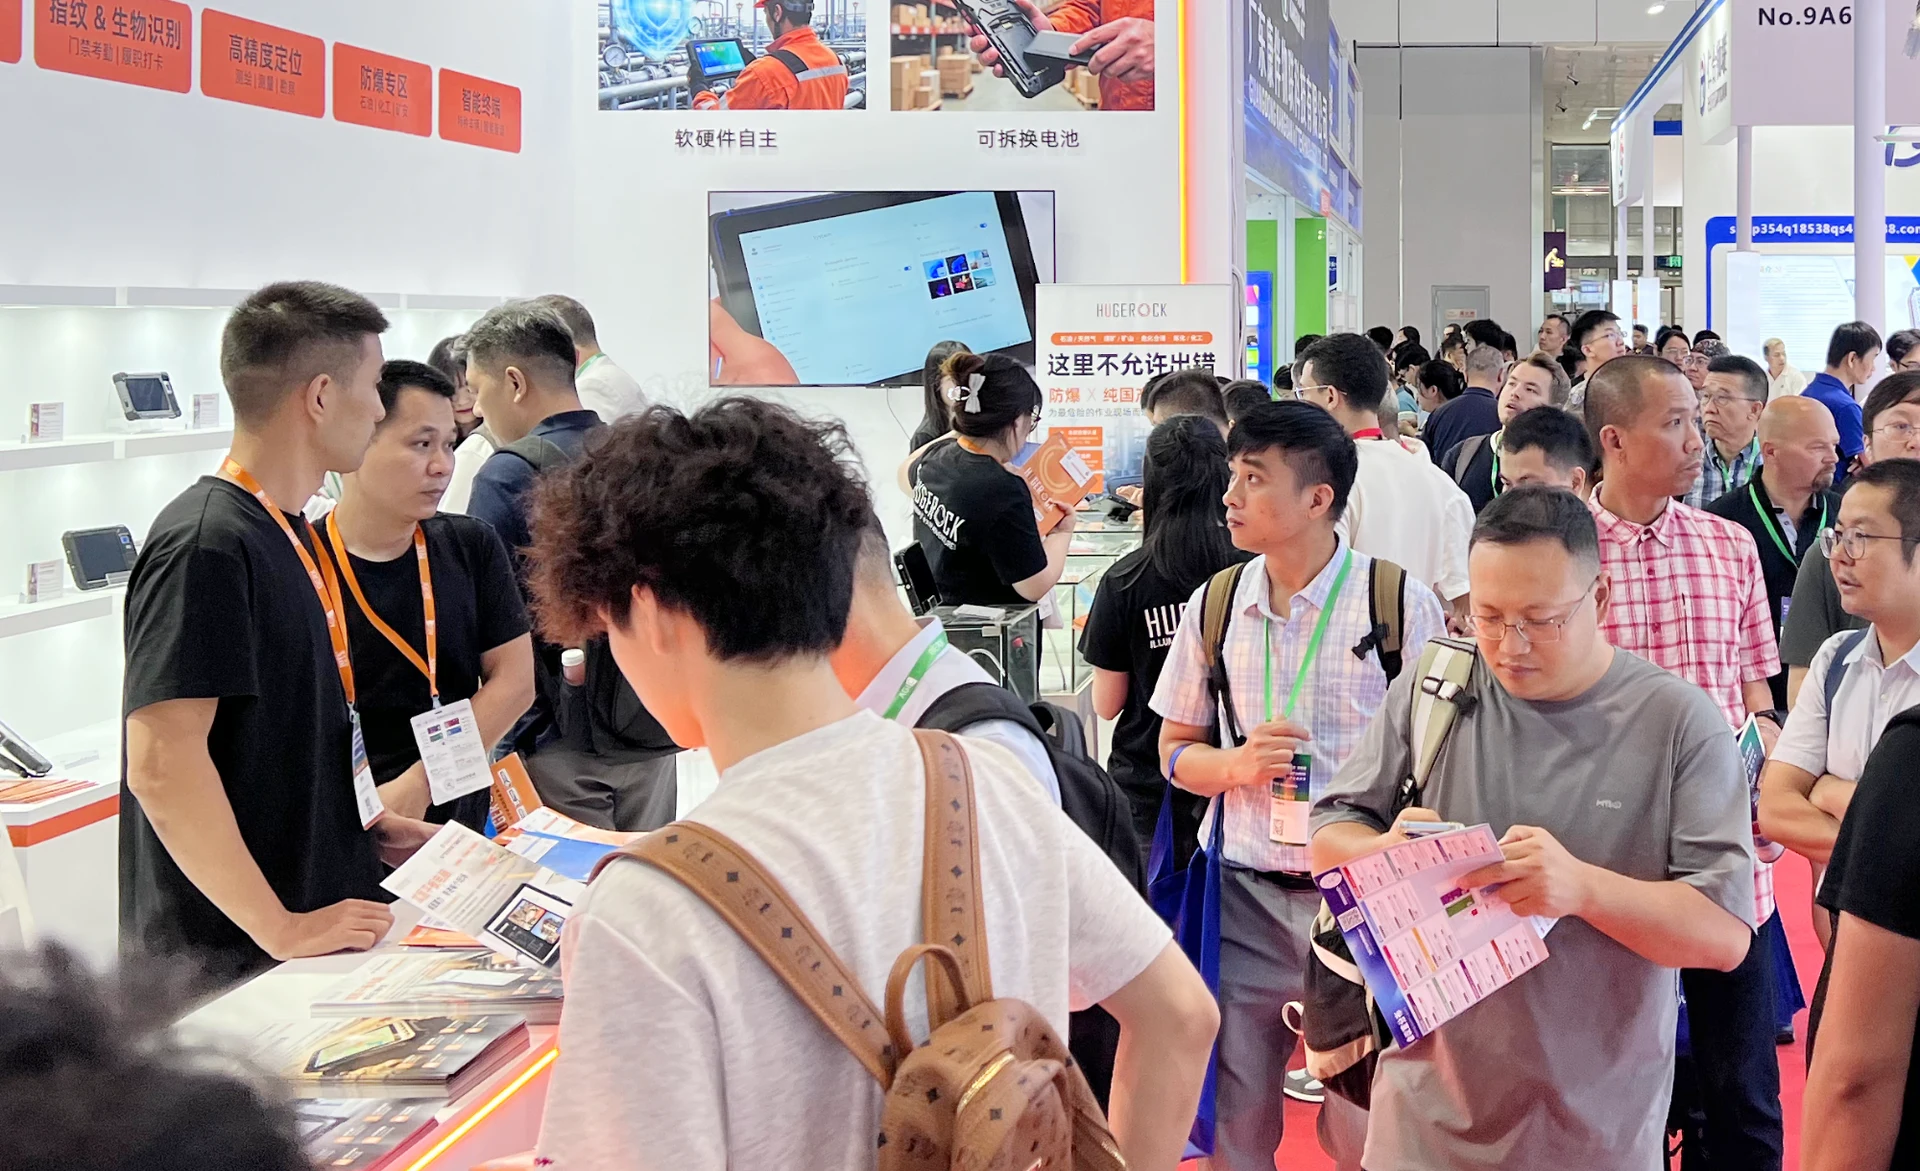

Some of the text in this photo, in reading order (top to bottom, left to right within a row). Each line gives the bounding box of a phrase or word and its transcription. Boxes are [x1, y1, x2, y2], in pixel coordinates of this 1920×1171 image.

[50, 0, 181, 50] 指纹 & 生物识别
[1758, 6, 1852, 26] No.9A6
[229, 34, 302, 76] 高精度定位
[360, 65, 408, 99] 防爆专区
[462, 87, 501, 119] 智能终端
[674, 129, 779, 149] 软硬件自主
[977, 129, 1080, 149] 可拆换电池
[1096, 303, 1167, 317] HUGEROCK
[1048, 352, 1216, 376] 这里不允许出错
[1049, 388, 1080, 403] 防爆
[1048, 408, 1147, 417] 为最危险的作业现场而
